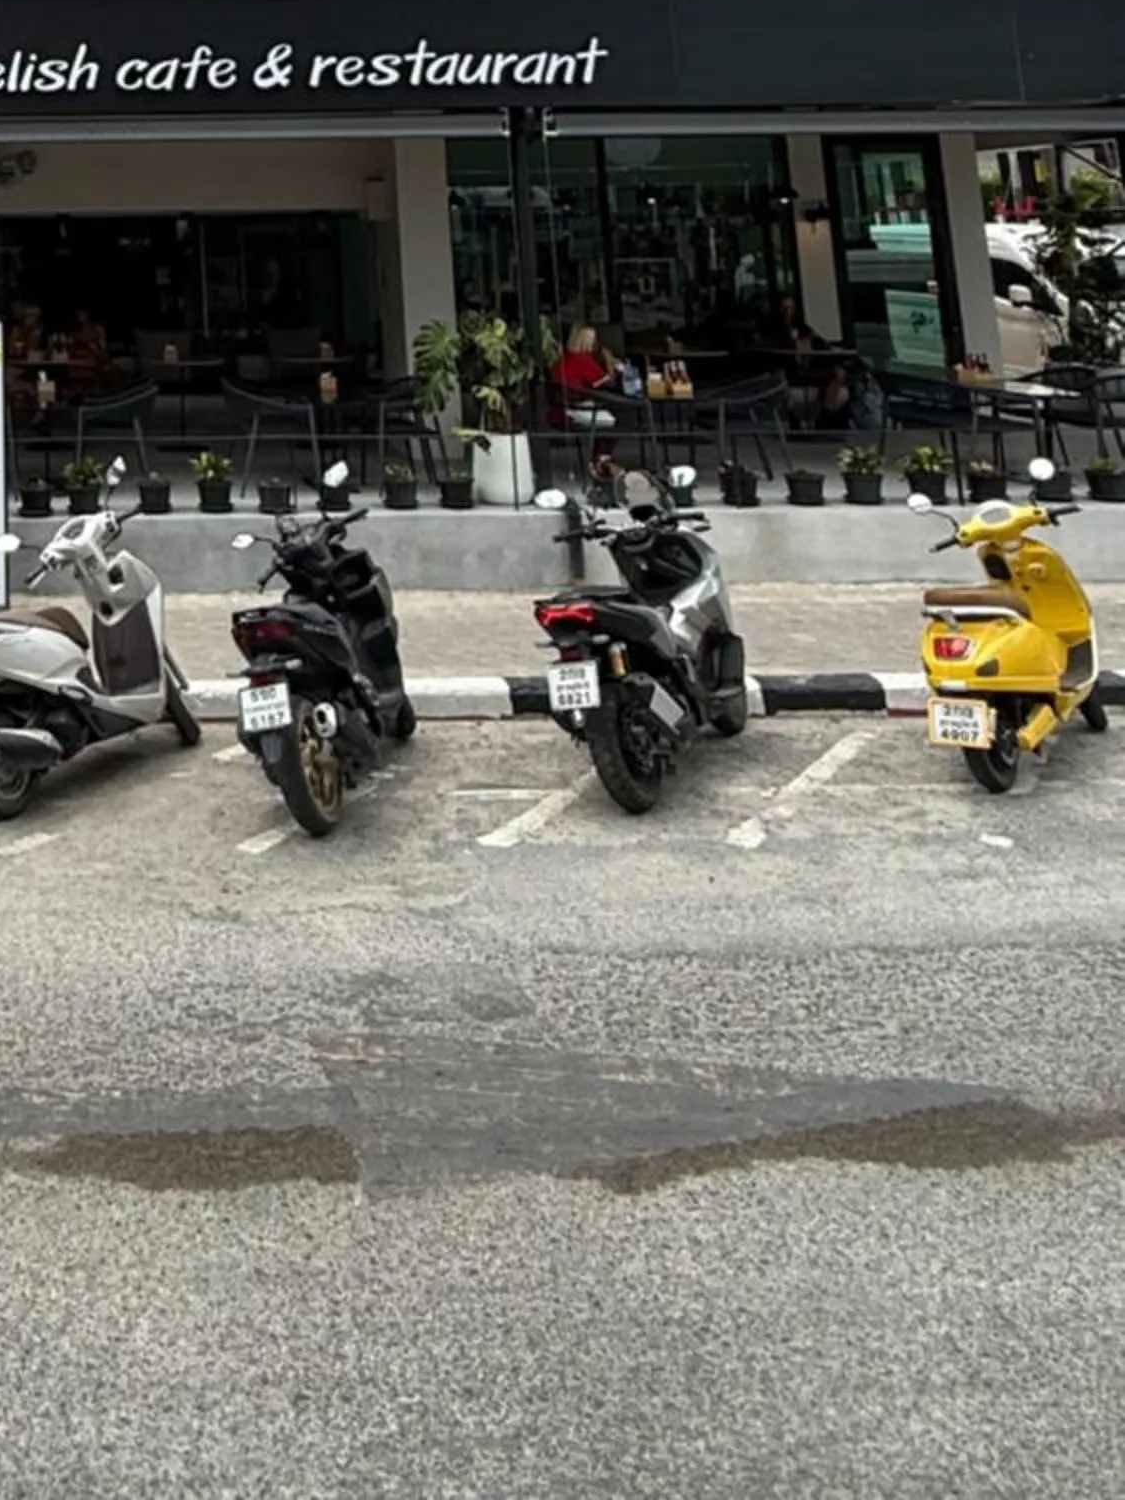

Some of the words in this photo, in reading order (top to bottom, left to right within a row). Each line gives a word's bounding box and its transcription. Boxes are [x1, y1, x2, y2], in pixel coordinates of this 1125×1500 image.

[116, 45, 237, 91] cafe
[253, 43, 293, 89] &
[309, 37, 608, 87] restaurant
